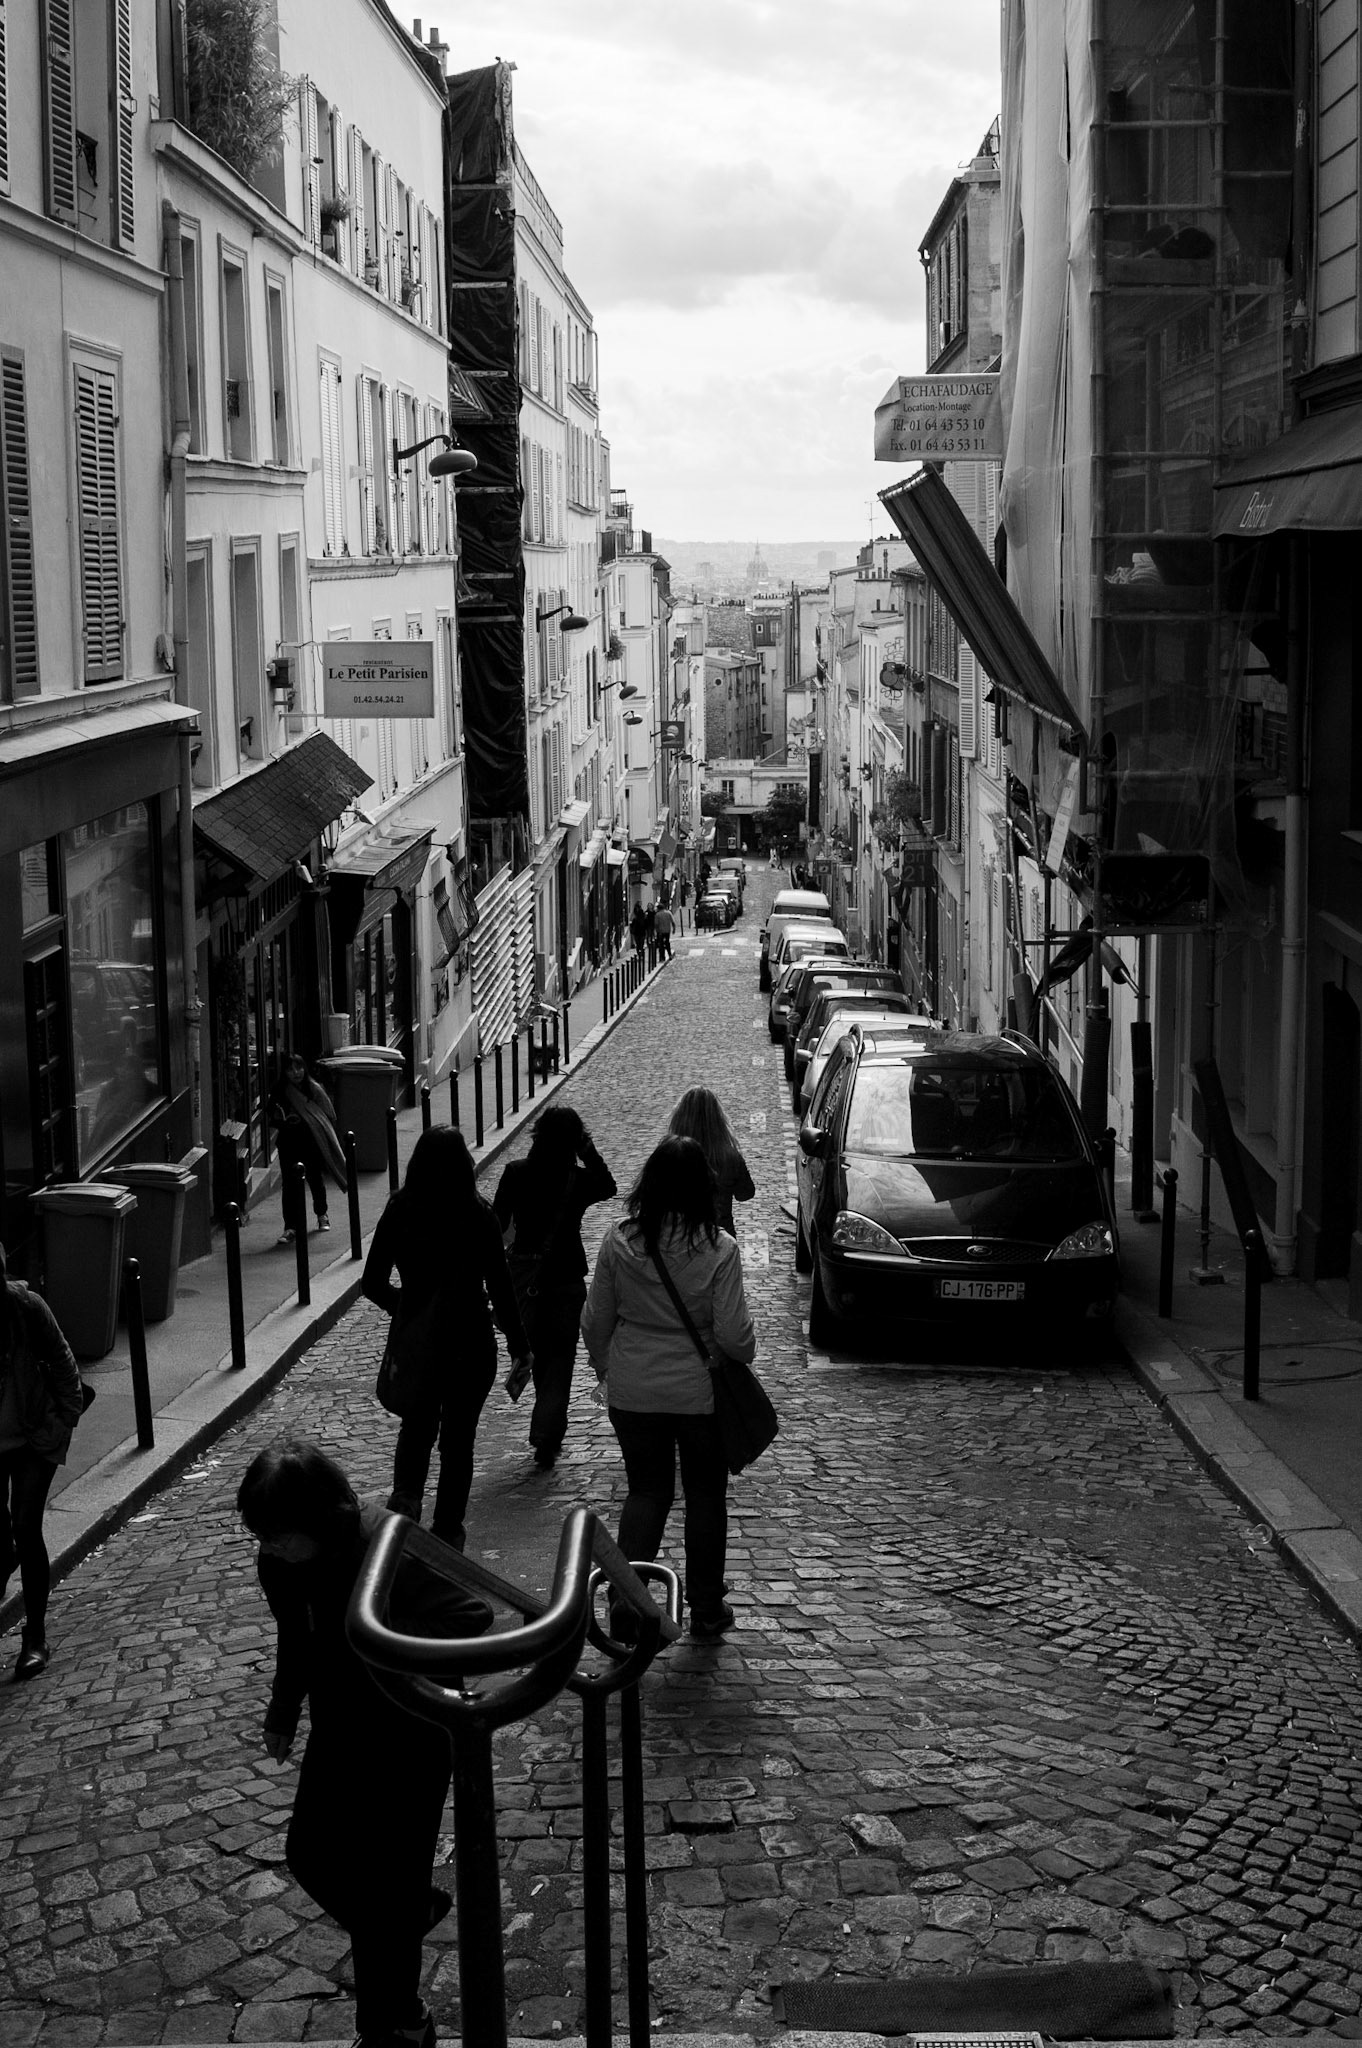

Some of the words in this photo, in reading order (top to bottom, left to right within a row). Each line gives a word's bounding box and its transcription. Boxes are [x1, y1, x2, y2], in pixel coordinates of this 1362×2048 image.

[904, 383, 993, 398] ECHAFAUDAGE
[903, 402, 972, 413] Location-Montage
[909, 419, 920, 431] 01
[925, 418, 937, 431] 64
[940, 419, 953, 431] 43
[957, 418, 969, 431] 53
[973, 418, 985, 431] 10
[890, 438, 907, 451] Fax.
[910, 439, 921, 451] 01
[926, 438, 938, 451] 64
[941, 438, 954, 451] 43
[957, 438, 970, 451] 53
[974, 438, 985, 451] 11
[329, 668, 344, 679] Le
[348, 667, 375, 679] Petit
[379, 667, 428, 679] Parisien
[353, 695, 404, 704] 01.42.54.24.21
[903, 865, 925, 882] 21
[942, 1281, 1015, 1298] CJ-176-PP
